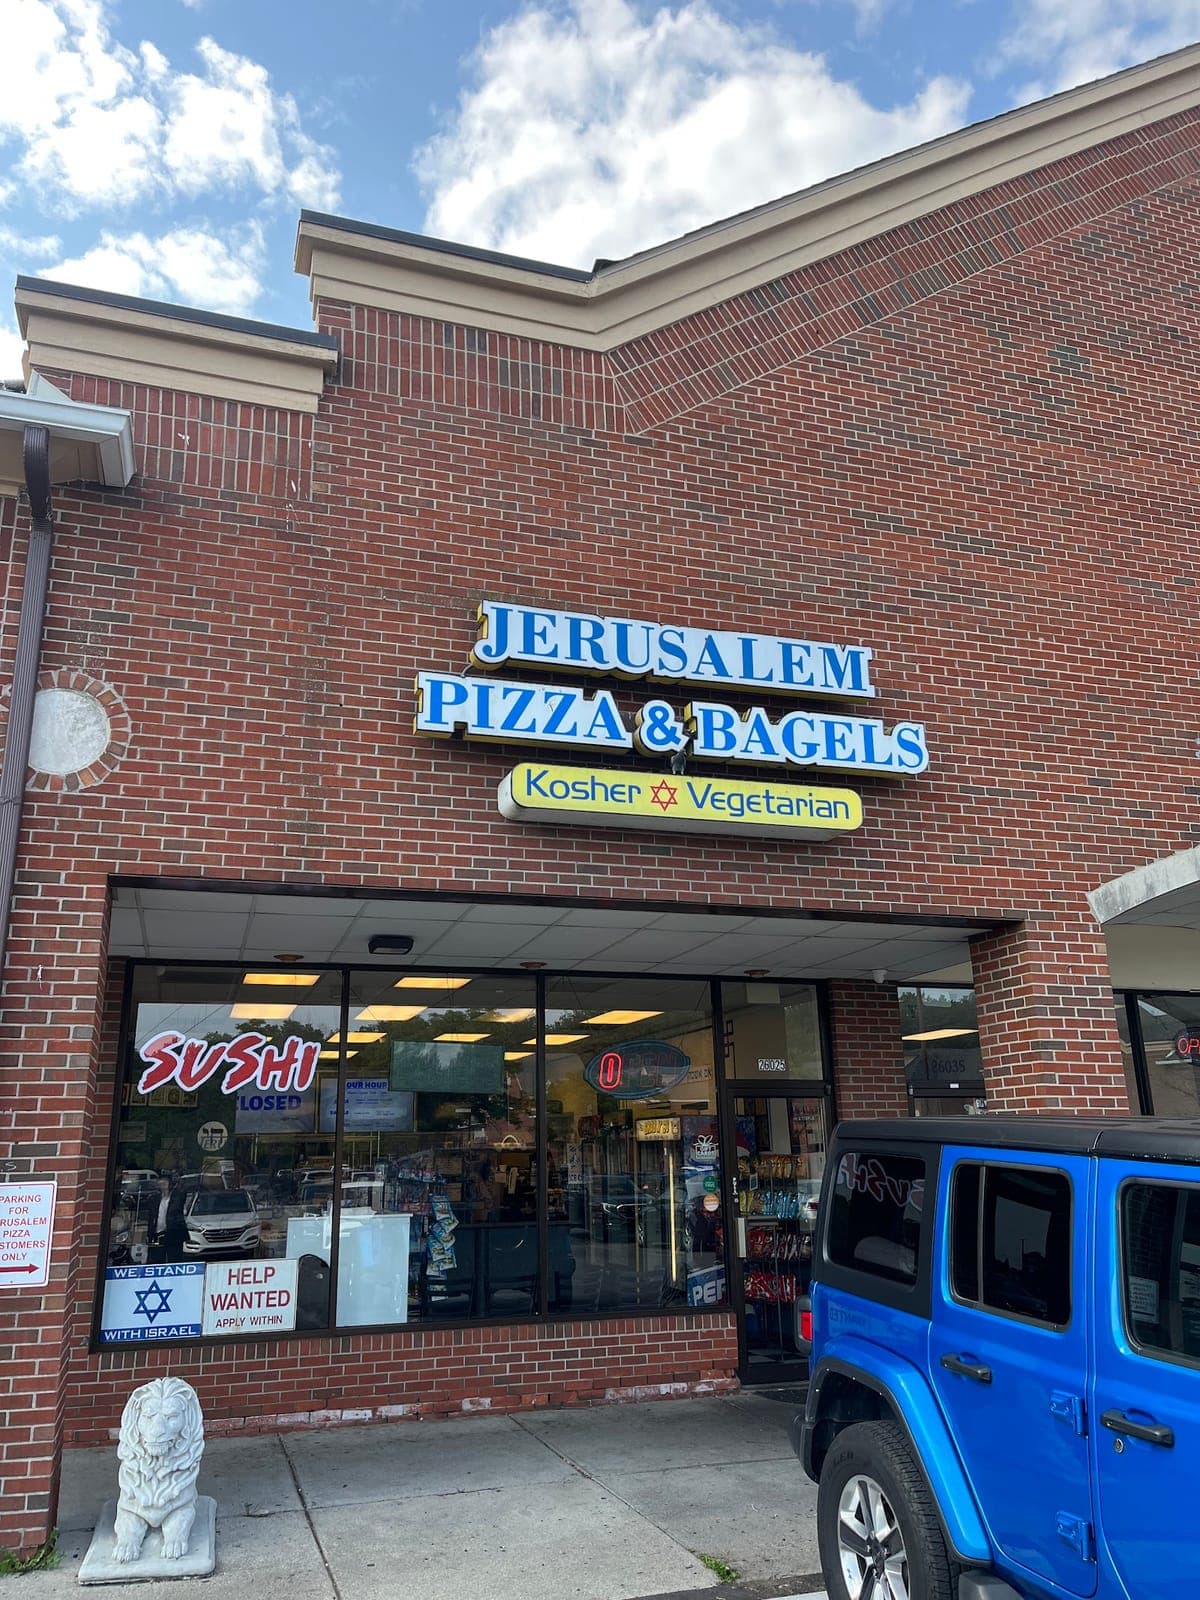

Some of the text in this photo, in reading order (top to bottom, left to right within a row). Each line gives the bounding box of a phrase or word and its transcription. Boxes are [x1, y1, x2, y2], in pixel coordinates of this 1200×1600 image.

[481, 604, 868, 692] JERUSALEM
[424, 677, 923, 769] PIZZA & BAGELS
[525, 769, 850, 820] Kosher Vegetarian
[1177, 1036, 1200, 1054] OP
[139, 1031, 320, 1093] SUSHI
[364, 1081, 388, 1090] HOUR
[236, 1095, 302, 1111] LOSED
[8, 1206, 29, 1215] FOR
[0, 1217, 47, 1227] RUSALEM
[3, 1229, 31, 1238] PIZZA
[0, 1240, 46, 1250] STOMERS
[1, 1252, 28, 1262] ONLY
[114, 1264, 197, 1278] WE STAND
[227, 1266, 276, 1286] HELP
[210, 1289, 291, 1312] WANTED
[215, 1315, 283, 1329] APPLY WITHIN
[104, 1326, 197, 1340] WITH ISRAEL
